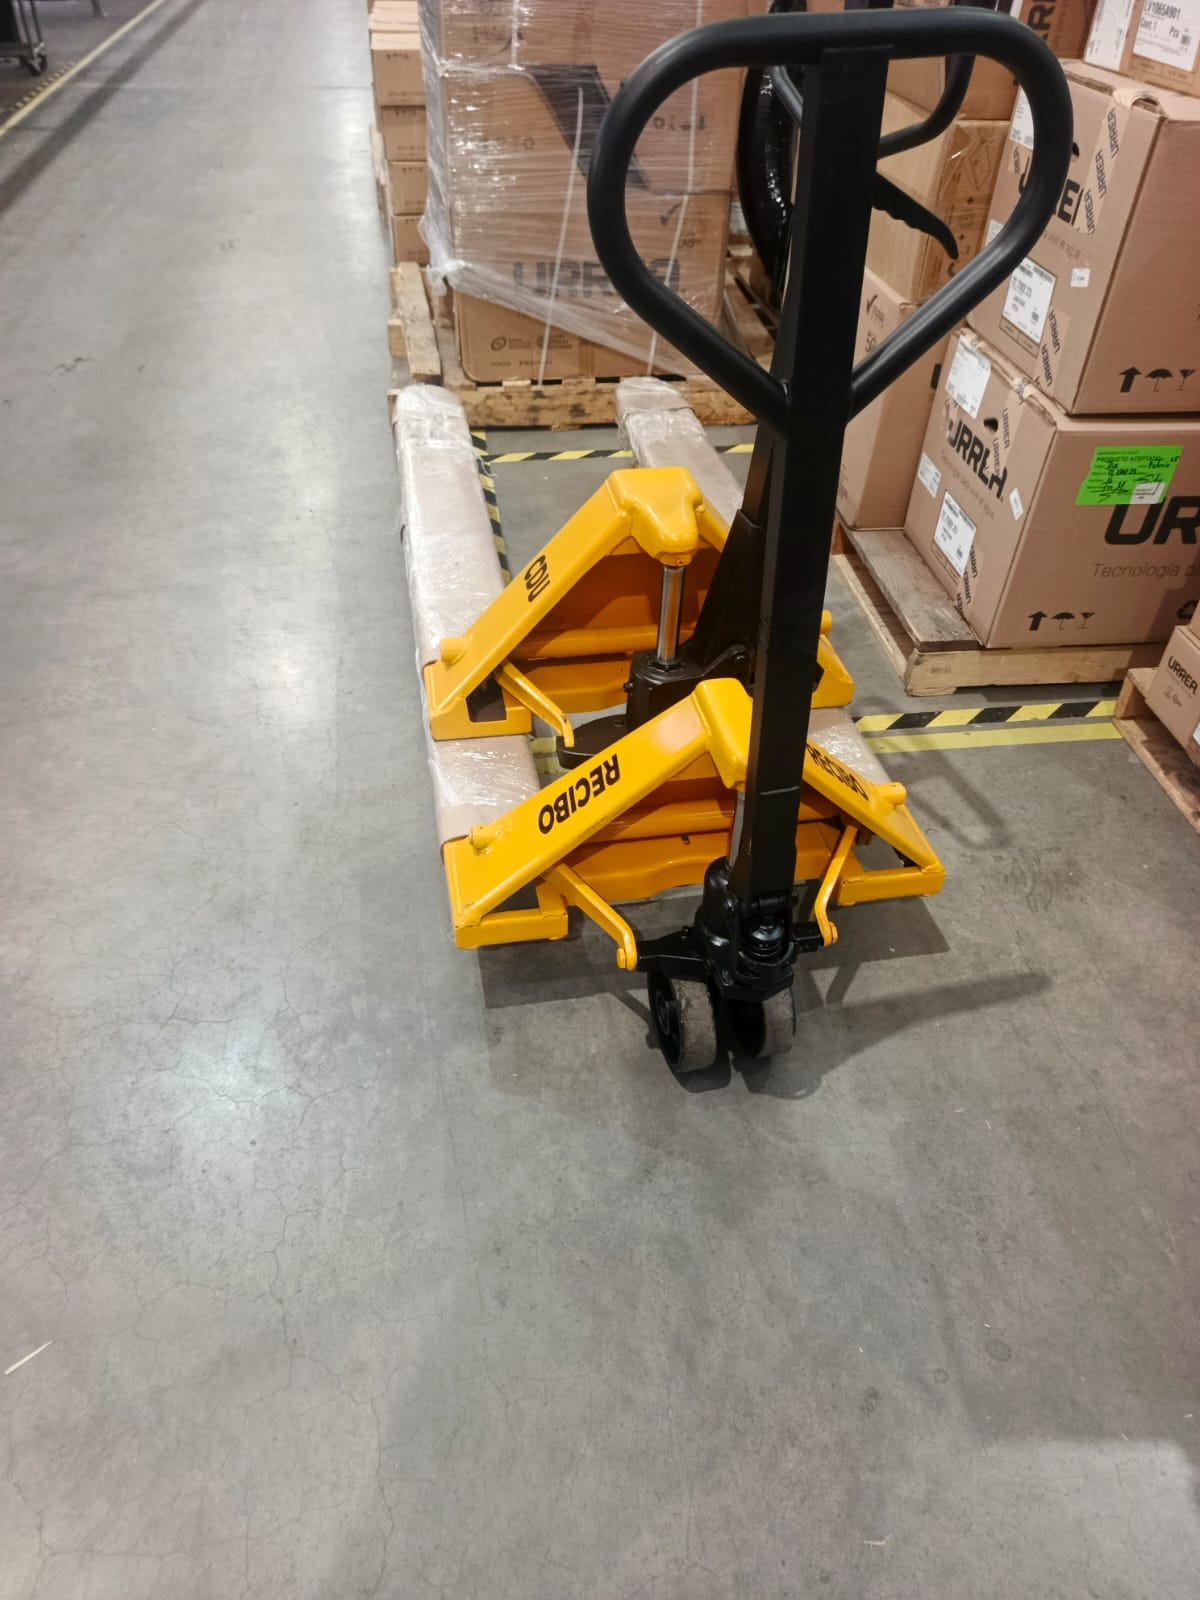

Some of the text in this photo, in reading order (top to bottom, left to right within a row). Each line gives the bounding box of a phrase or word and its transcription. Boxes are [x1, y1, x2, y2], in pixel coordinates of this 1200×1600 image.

[1107, 107, 1119, 158] URREA
[1095, 148, 1106, 199] URREA
[513, 258, 681, 298] URRA
[1167, 655, 1198, 696] URREA
[538, 753, 620, 835] RECIBO
[806, 742, 870, 802] RECIBO
